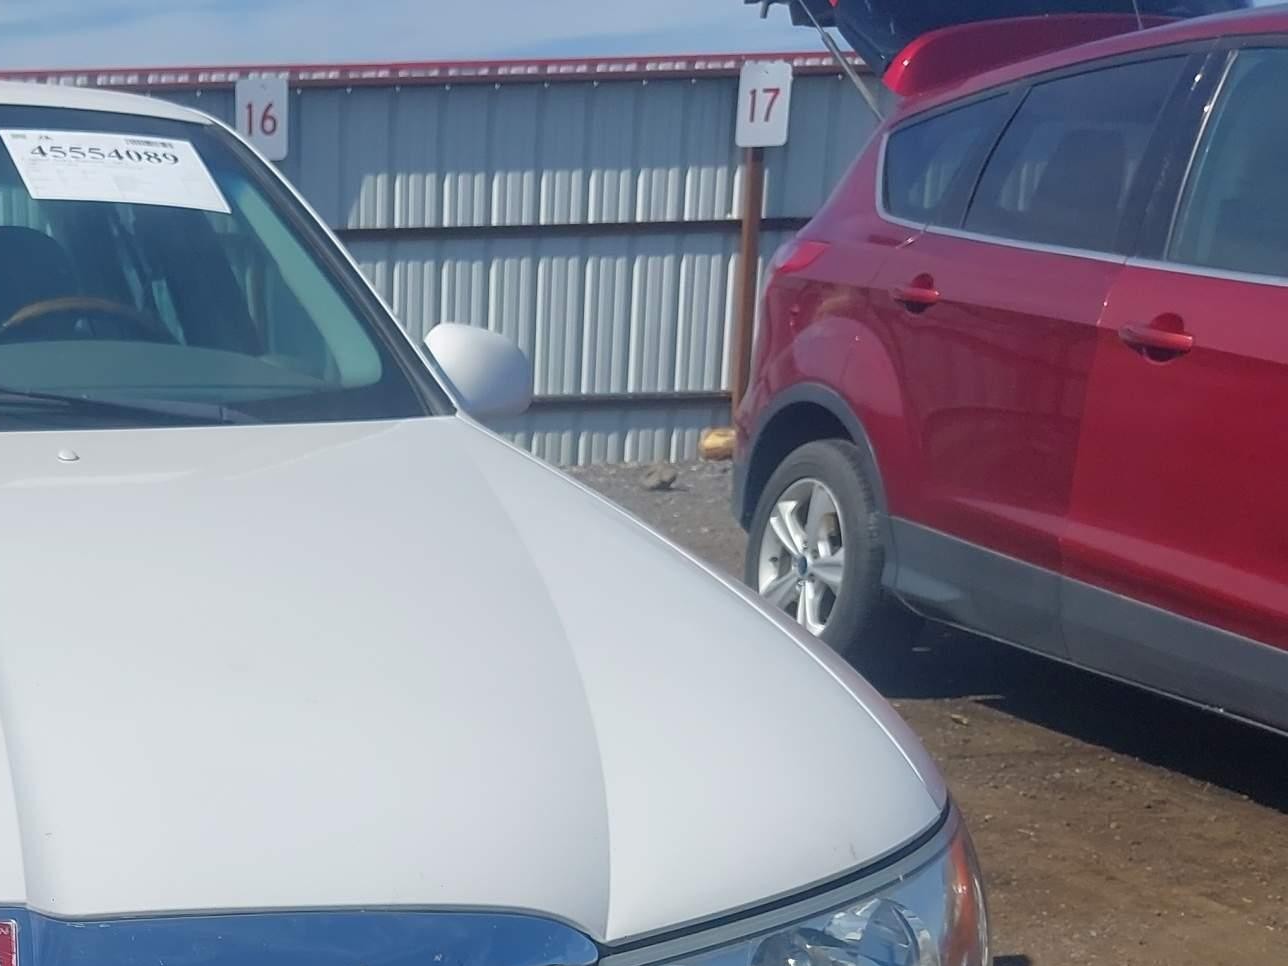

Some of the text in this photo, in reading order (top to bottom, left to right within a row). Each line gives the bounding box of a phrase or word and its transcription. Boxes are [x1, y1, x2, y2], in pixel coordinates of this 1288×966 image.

[245, 101, 278, 136] 16
[749, 87, 781, 123] 17
[30, 145, 179, 164] 45554089
